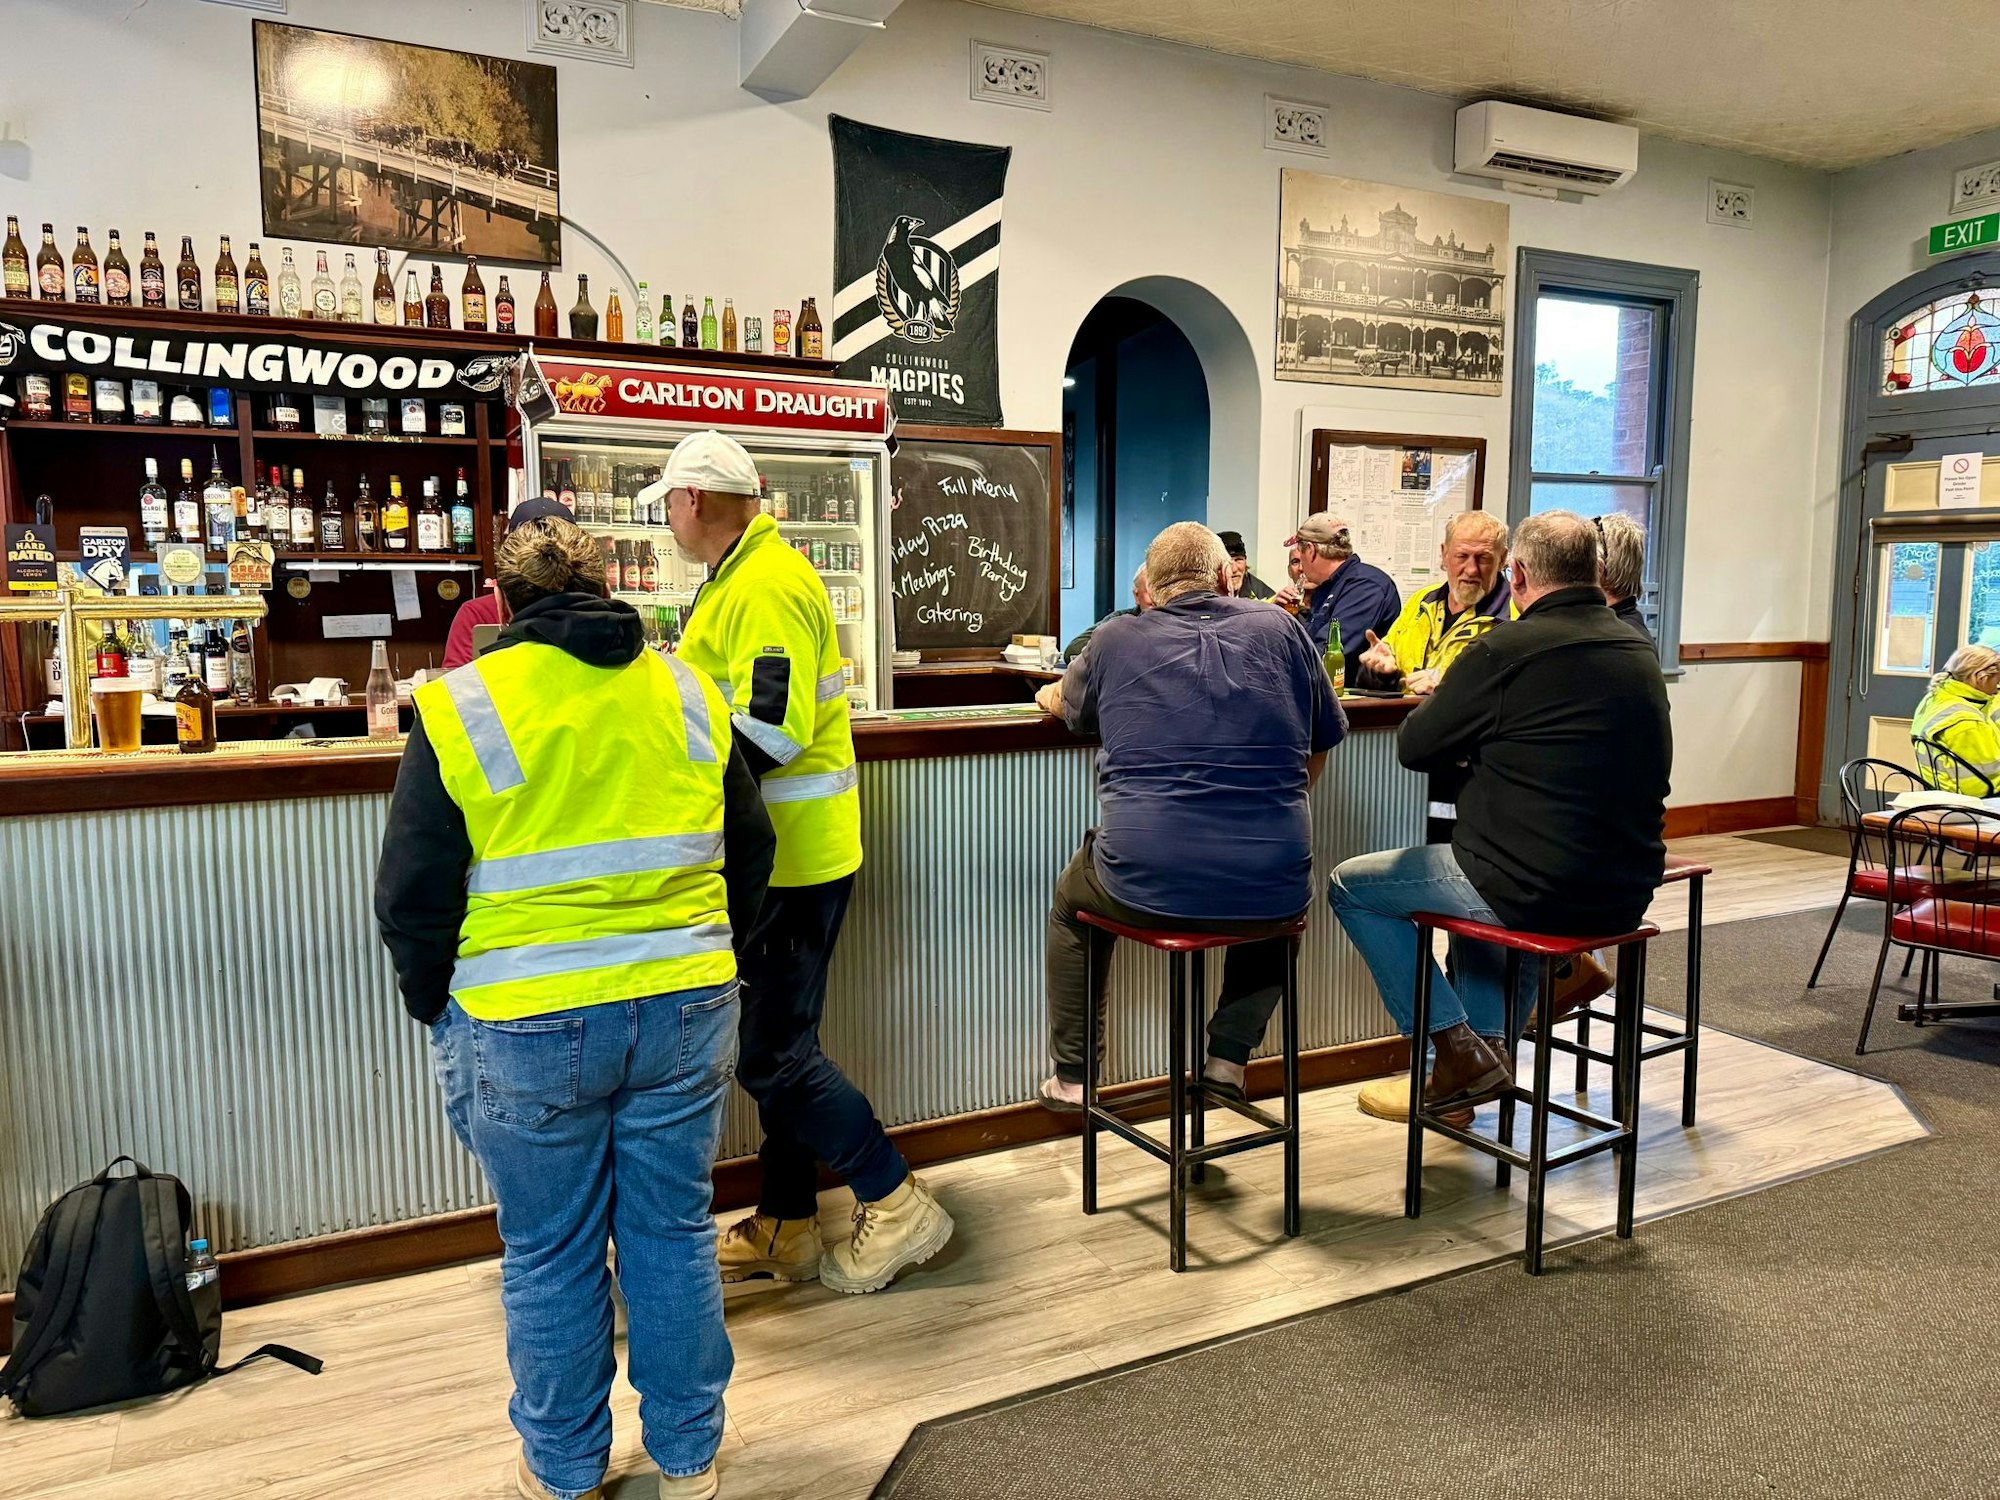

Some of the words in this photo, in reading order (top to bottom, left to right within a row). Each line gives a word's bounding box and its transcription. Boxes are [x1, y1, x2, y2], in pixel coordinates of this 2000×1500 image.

[1944, 219, 1986, 248] EXIT
[909, 323, 928, 338] 1892
[30, 324, 455, 390] COLLINGWOOD
[886, 353, 949, 370] COLLINGWOOD
[870, 365, 965, 406] MAGPIES
[618, 378, 745, 411] CARLTON
[755, 388, 878, 420] DRAUGHT
[213, 415, 229, 423] vok
[937, 475, 968, 497] Full
[16, 542, 46, 551] HARD
[82, 538, 126, 546] CARLTON
[83, 546, 126, 558] DRY
[8, 551, 55, 562] RATED
[967, 536, 1028, 593] Birthday
[231, 565, 268, 574] GREAT
[901, 562, 956, 597] Meetings
[979, 561, 1019, 602] Party
[917, 602, 983, 633] Catering
